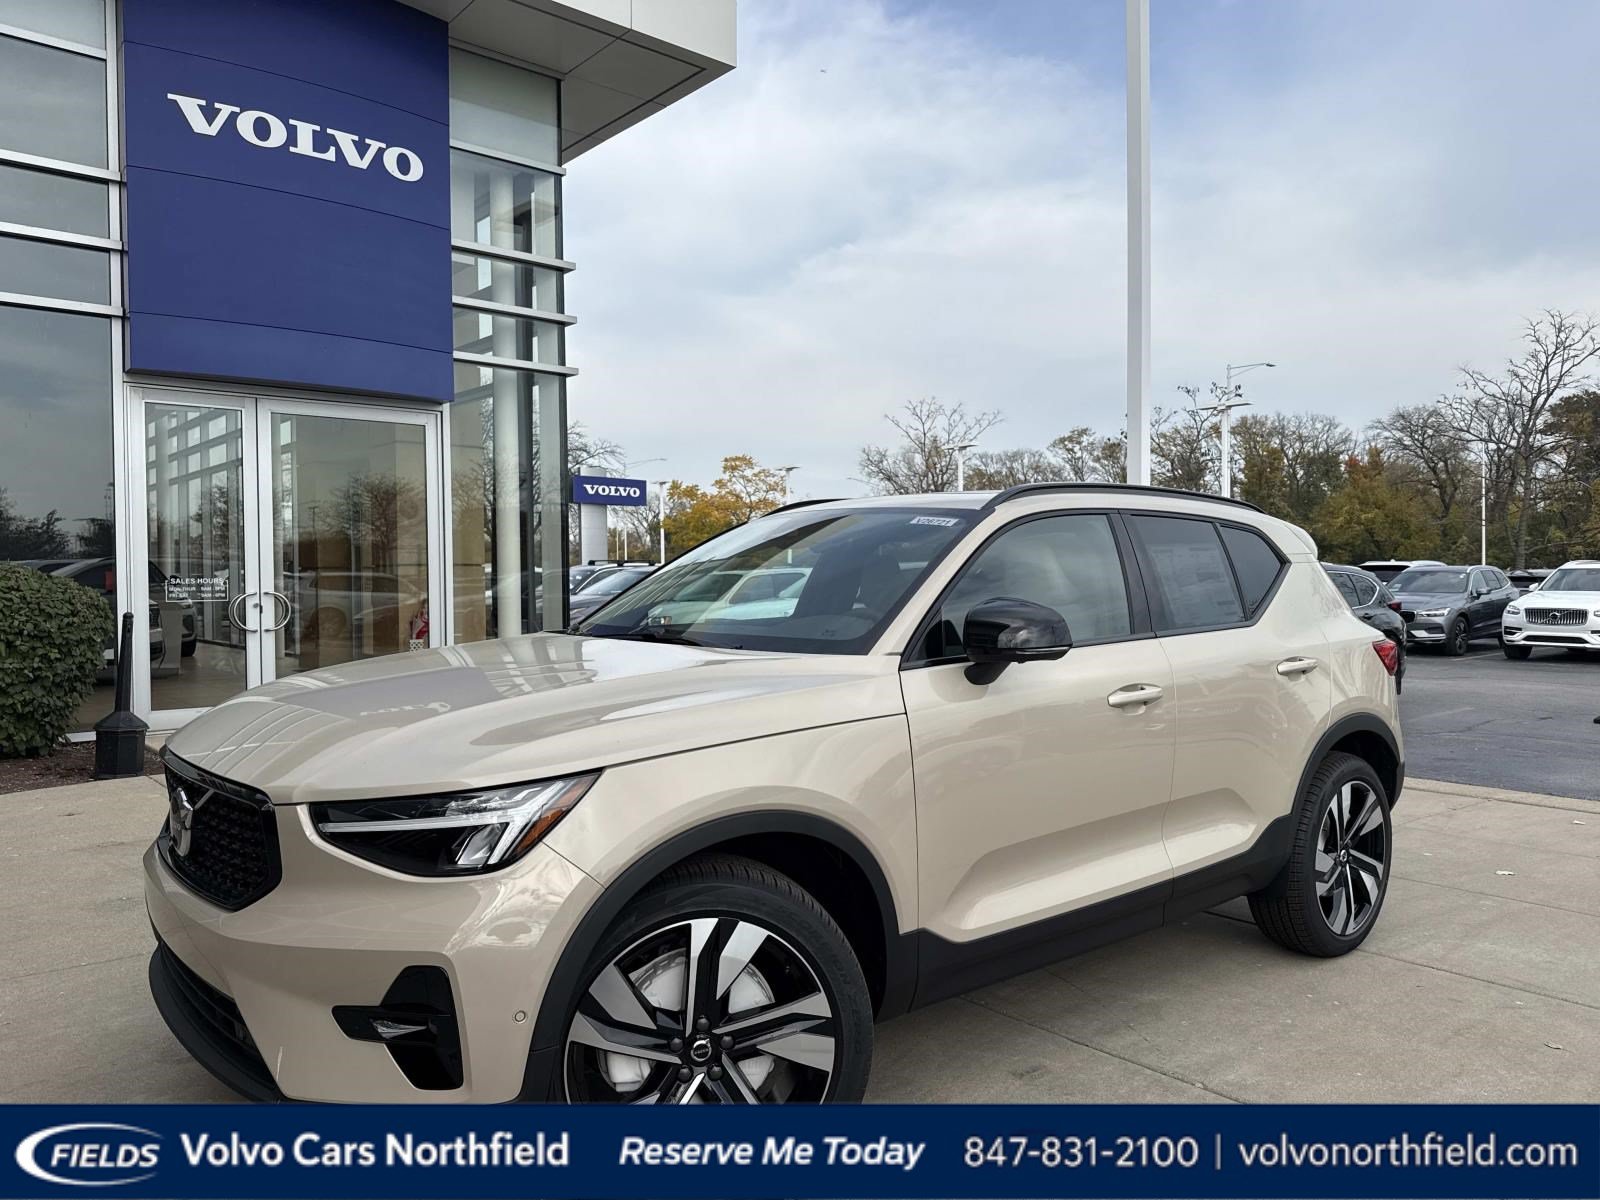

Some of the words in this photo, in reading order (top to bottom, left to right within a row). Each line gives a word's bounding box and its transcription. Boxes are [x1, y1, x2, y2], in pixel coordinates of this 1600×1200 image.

[167, 92, 424, 183] VOLVO
[583, 484, 641, 498] VOLVO
[170, 577, 196, 585] SALES
[197, 577, 224, 586] HOURS
